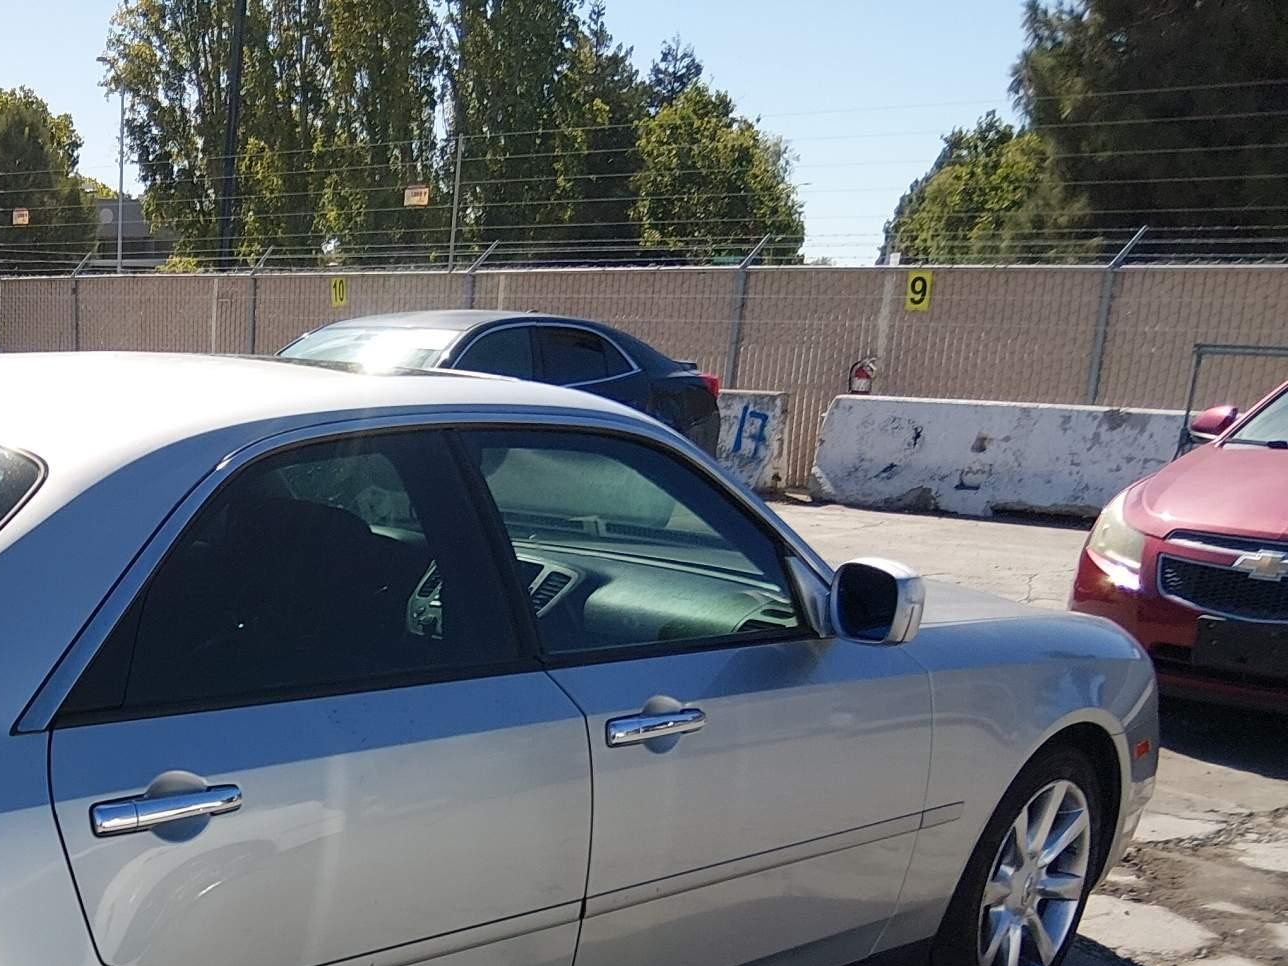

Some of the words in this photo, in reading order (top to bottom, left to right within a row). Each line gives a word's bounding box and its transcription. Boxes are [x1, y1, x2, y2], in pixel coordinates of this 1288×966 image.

[333, 279, 344, 302] 10
[910, 276, 927, 305] 9
[731, 402, 769, 459] 17
